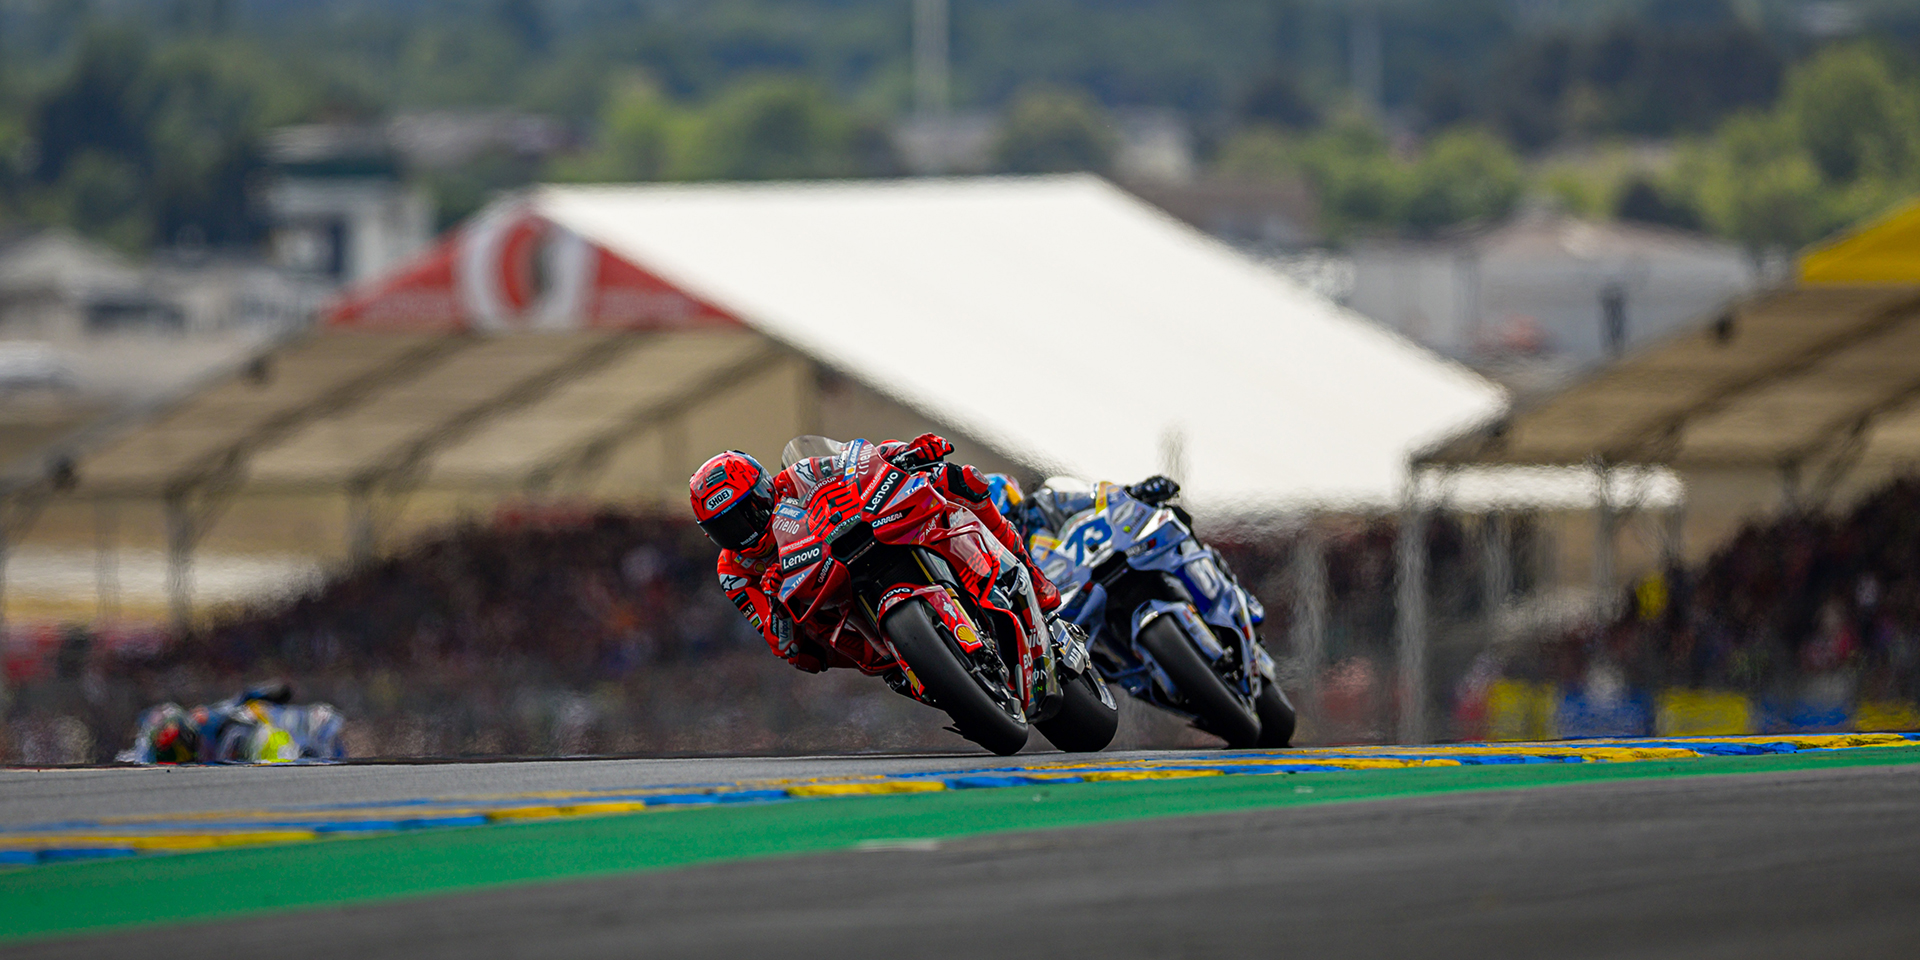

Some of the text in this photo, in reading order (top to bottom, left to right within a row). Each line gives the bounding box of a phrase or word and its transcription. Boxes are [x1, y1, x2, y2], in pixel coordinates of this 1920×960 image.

[708, 490, 730, 509] SHOEI
[865, 472, 899, 512] Lenovo
[871, 512, 903, 528] CARRERA
[1065, 516, 1112, 567] 73
[782, 547, 820, 569] Lenovo
[791, 573, 805, 589] TIM
